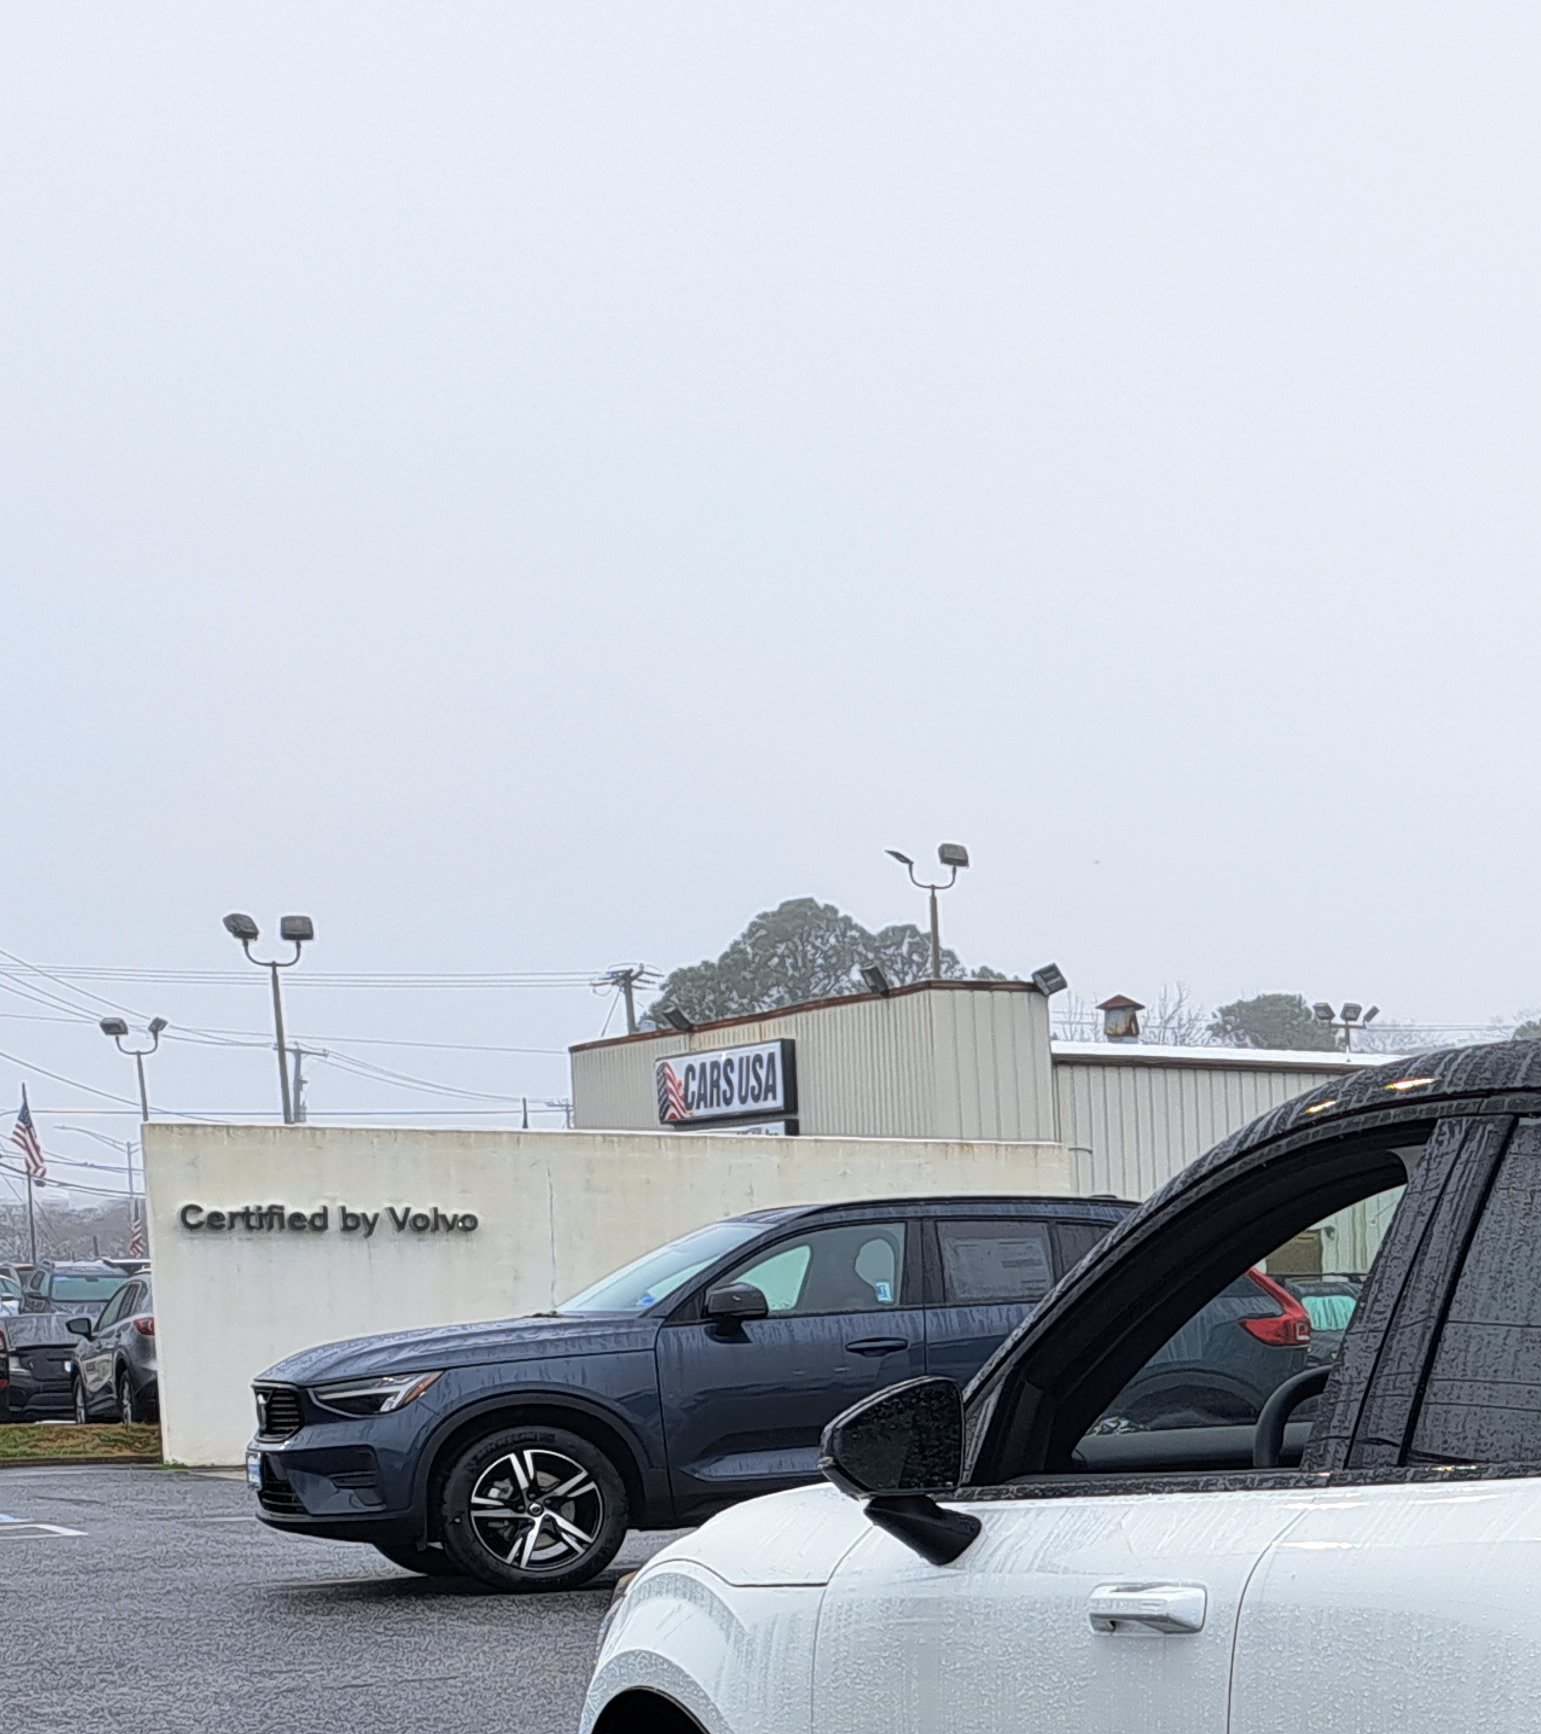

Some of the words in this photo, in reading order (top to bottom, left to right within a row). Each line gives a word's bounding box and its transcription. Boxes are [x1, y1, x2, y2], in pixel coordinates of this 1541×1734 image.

[684, 1057, 735, 1111] CARS
[738, 1051, 778, 1105] USA
[180, 1204, 329, 1231] Certified
[340, 1205, 379, 1238] by
[386, 1206, 479, 1232] Volvo
